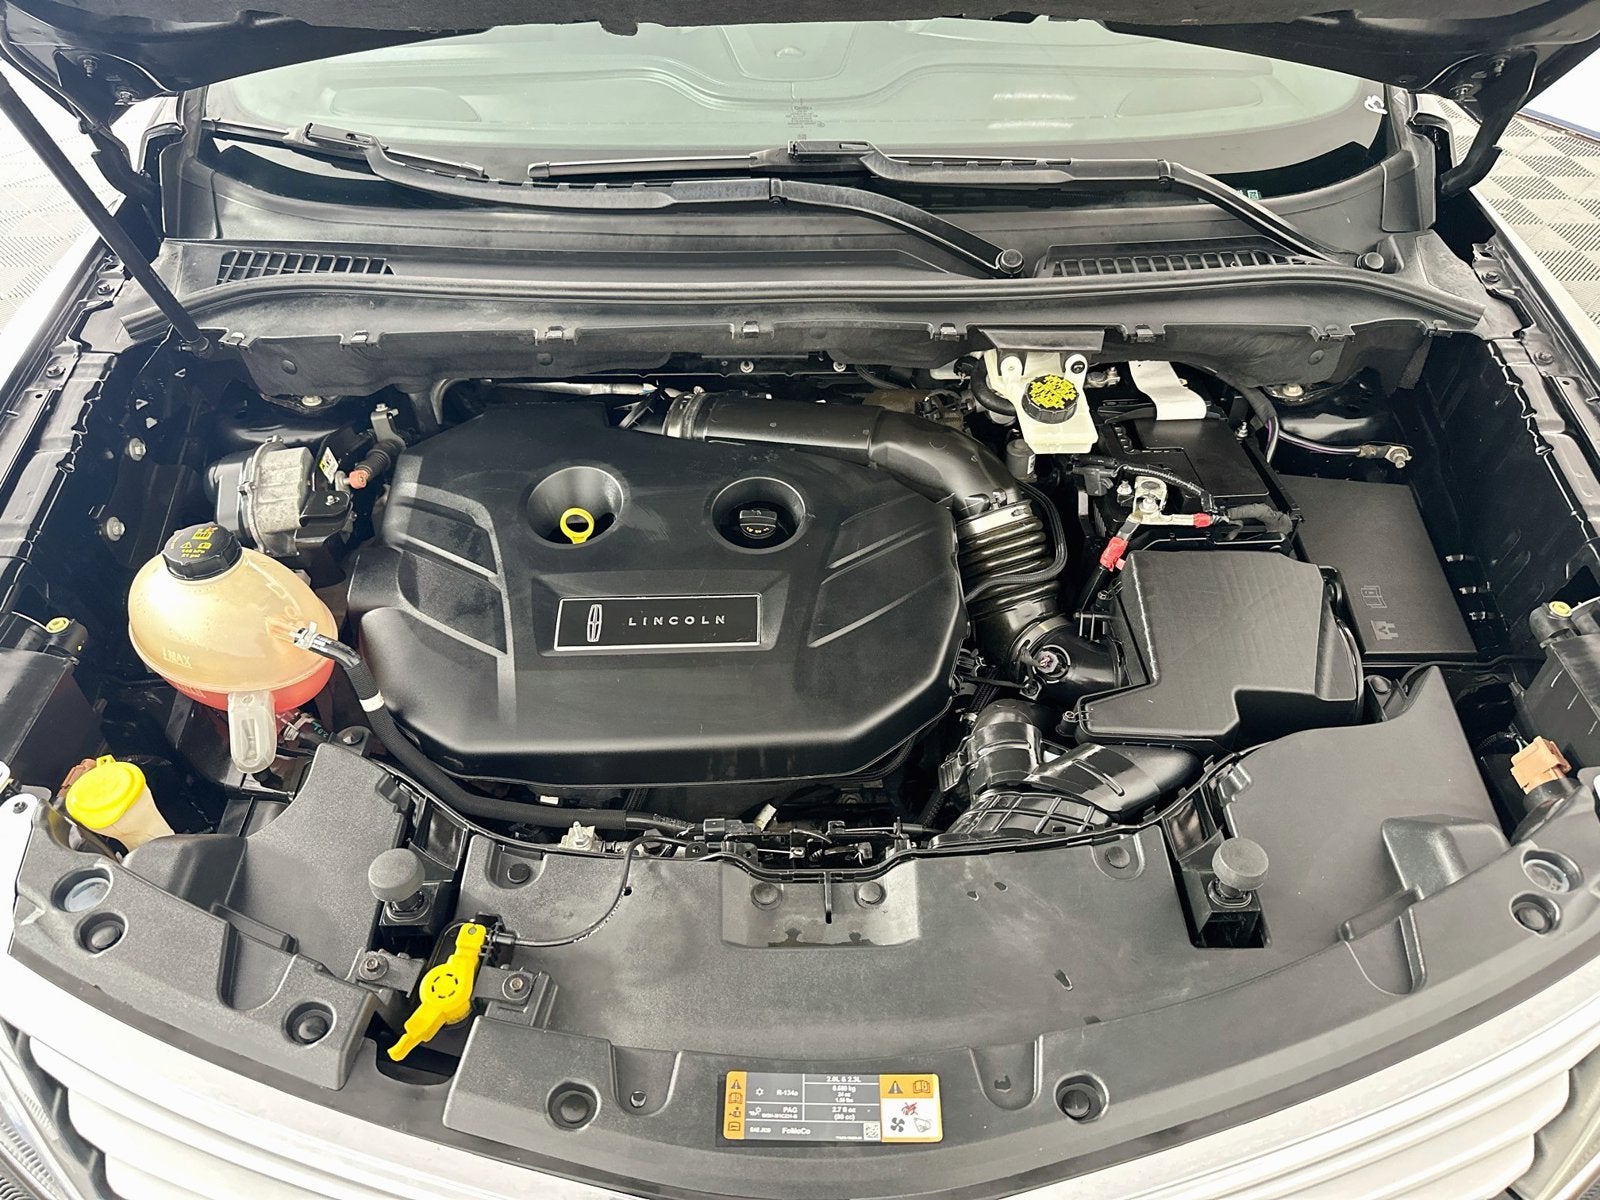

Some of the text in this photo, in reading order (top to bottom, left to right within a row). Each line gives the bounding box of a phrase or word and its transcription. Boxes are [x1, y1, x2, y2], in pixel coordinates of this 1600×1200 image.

[628, 615, 726, 627] LINCOLN
[848, 1085, 857, 1093] kg
[782, 1127, 811, 1135] FoMoCo
